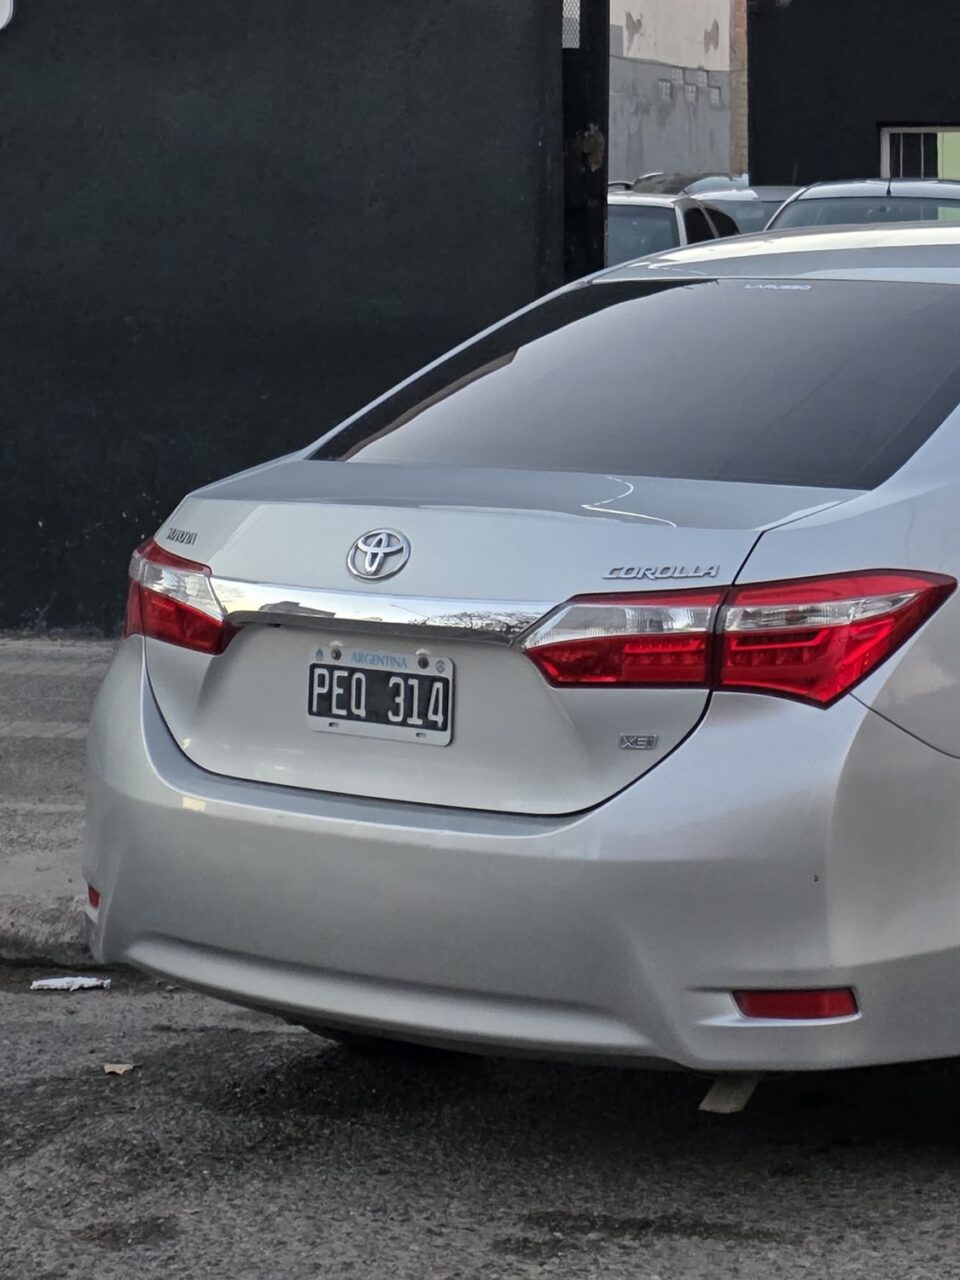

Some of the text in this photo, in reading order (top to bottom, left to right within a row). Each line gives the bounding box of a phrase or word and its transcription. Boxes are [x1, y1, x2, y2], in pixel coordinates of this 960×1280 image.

[602, 565, 720, 580] COROLLA
[351, 651, 408, 669] ARGENTINA
[311, 668, 445, 728] PEQ 314
